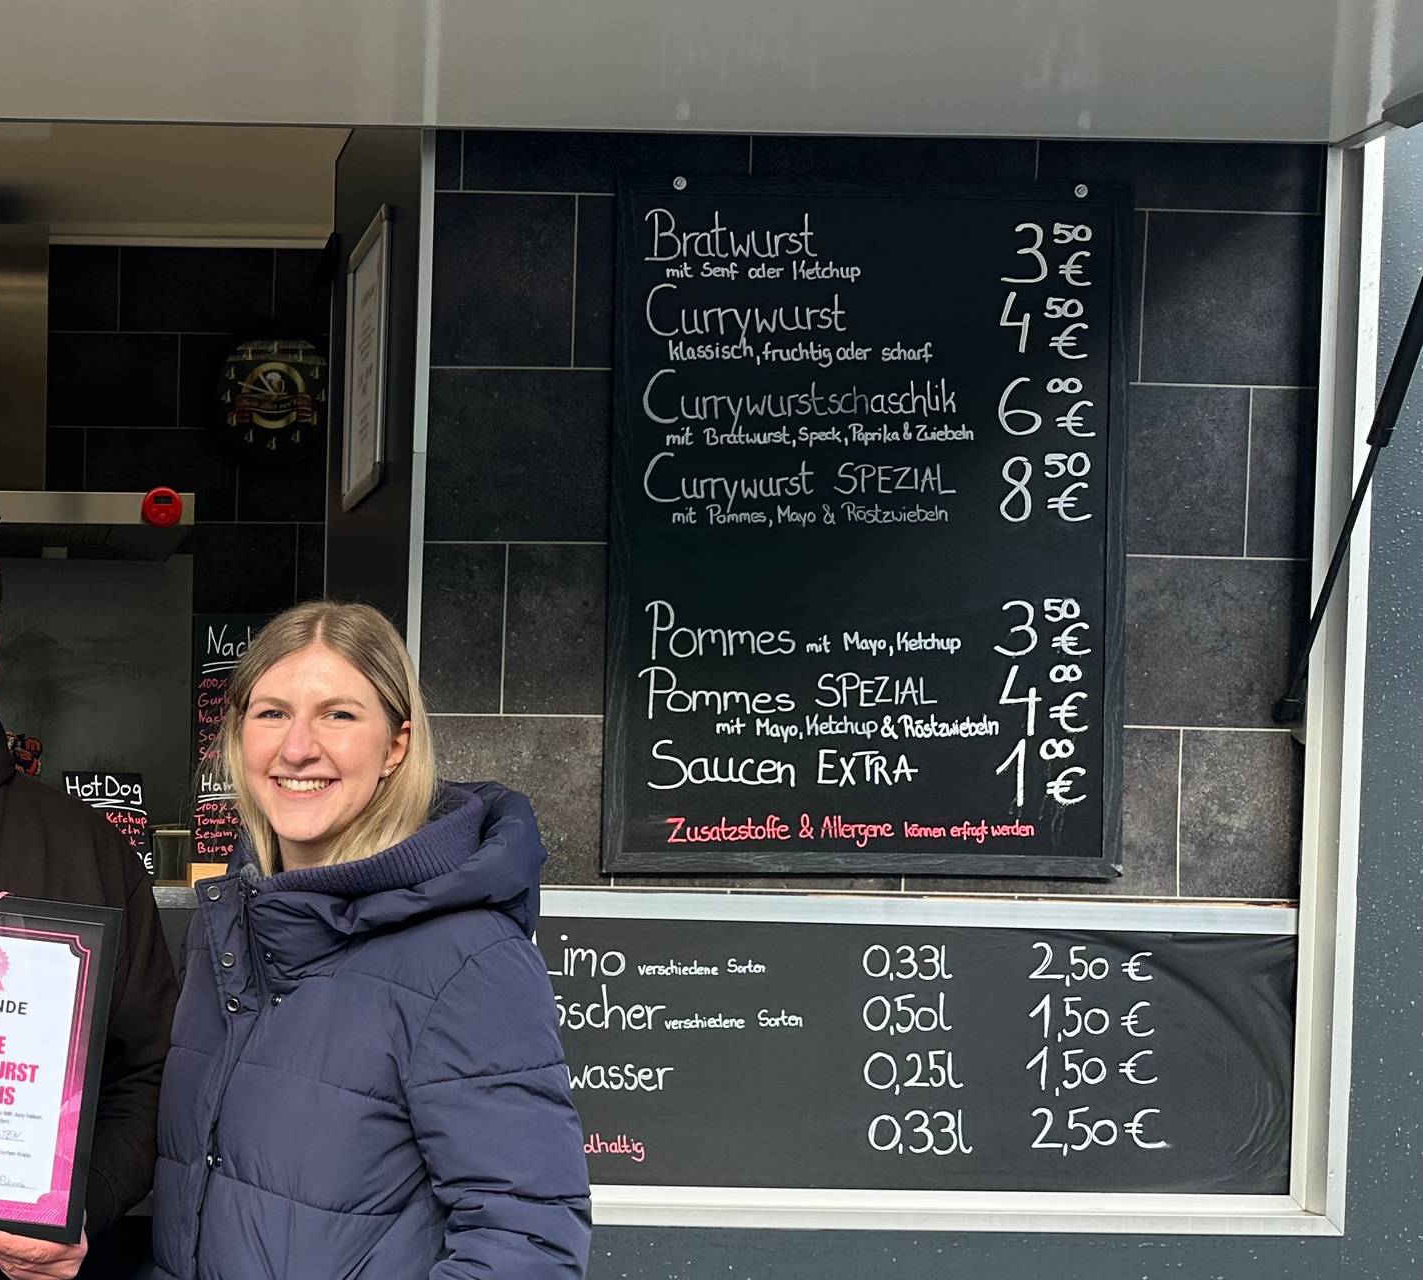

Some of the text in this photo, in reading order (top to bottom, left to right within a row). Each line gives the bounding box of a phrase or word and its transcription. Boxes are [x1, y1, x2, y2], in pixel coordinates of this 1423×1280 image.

[644, 208, 818, 262] Bratwurst
[1001, 222, 1049, 284] 3
[666, 261, 861, 281] mit Senf oder Ketchup
[646, 283, 847, 350] Currywurst
[999, 291, 1031, 354] 4
[763, 341, 833, 368] fruchtig
[836, 343, 872, 362] oder
[881, 342, 934, 364] scharf
[642, 369, 957, 433] Currywurstschaschlik
[998, 377, 1043, 437] 6
[666, 423, 974, 449] mit Bratwurst, Speck, Paprika & Zwiebeln
[643, 452, 815, 512] Currywurst
[833, 462, 957, 496] SPEZIAL
[1000, 456, 1033, 523] 8
[672, 502, 949, 527] mit Pommes, Mayo & Röstzwiebeln
[644, 600, 796, 660] Pommes
[806, 636, 831, 655] mit
[993, 600, 1038, 657] 3
[638, 666, 795, 719] Pommes
[815, 672, 938, 708] SPEZIAL
[998, 664, 1042, 737] 4
[715, 719, 746, 735] mit
[880, 718, 899, 740] &
[647, 739, 796, 790] Saucen
[996, 739, 1026, 807] 1
[106, 812, 147, 829] Ketchup
[665, 813, 1035, 847] Zusatzstoffe & Allergene können erfragt werden
[637, 960, 719, 976] verschiedene
[727, 958, 766, 974] Sorten
[862, 944, 953, 981] 0,33l
[1028, 942, 1109, 987] 2,50
[1121, 952, 1153, 981] €
[664, 1013, 745, 1030] verschiedene
[757, 1009, 803, 1028] Sorten
[862, 991, 953, 1036] 0,50l
[1028, 993, 1110, 1042] 1,50
[1120, 1001, 1155, 1037] €
[863, 1049, 964, 1095] 0,25l
[1025, 1046, 1107, 1096] 1,50
[1118, 1050, 1158, 1084] €
[868, 1106, 1169, 1156] 0,33l 2,50 €
